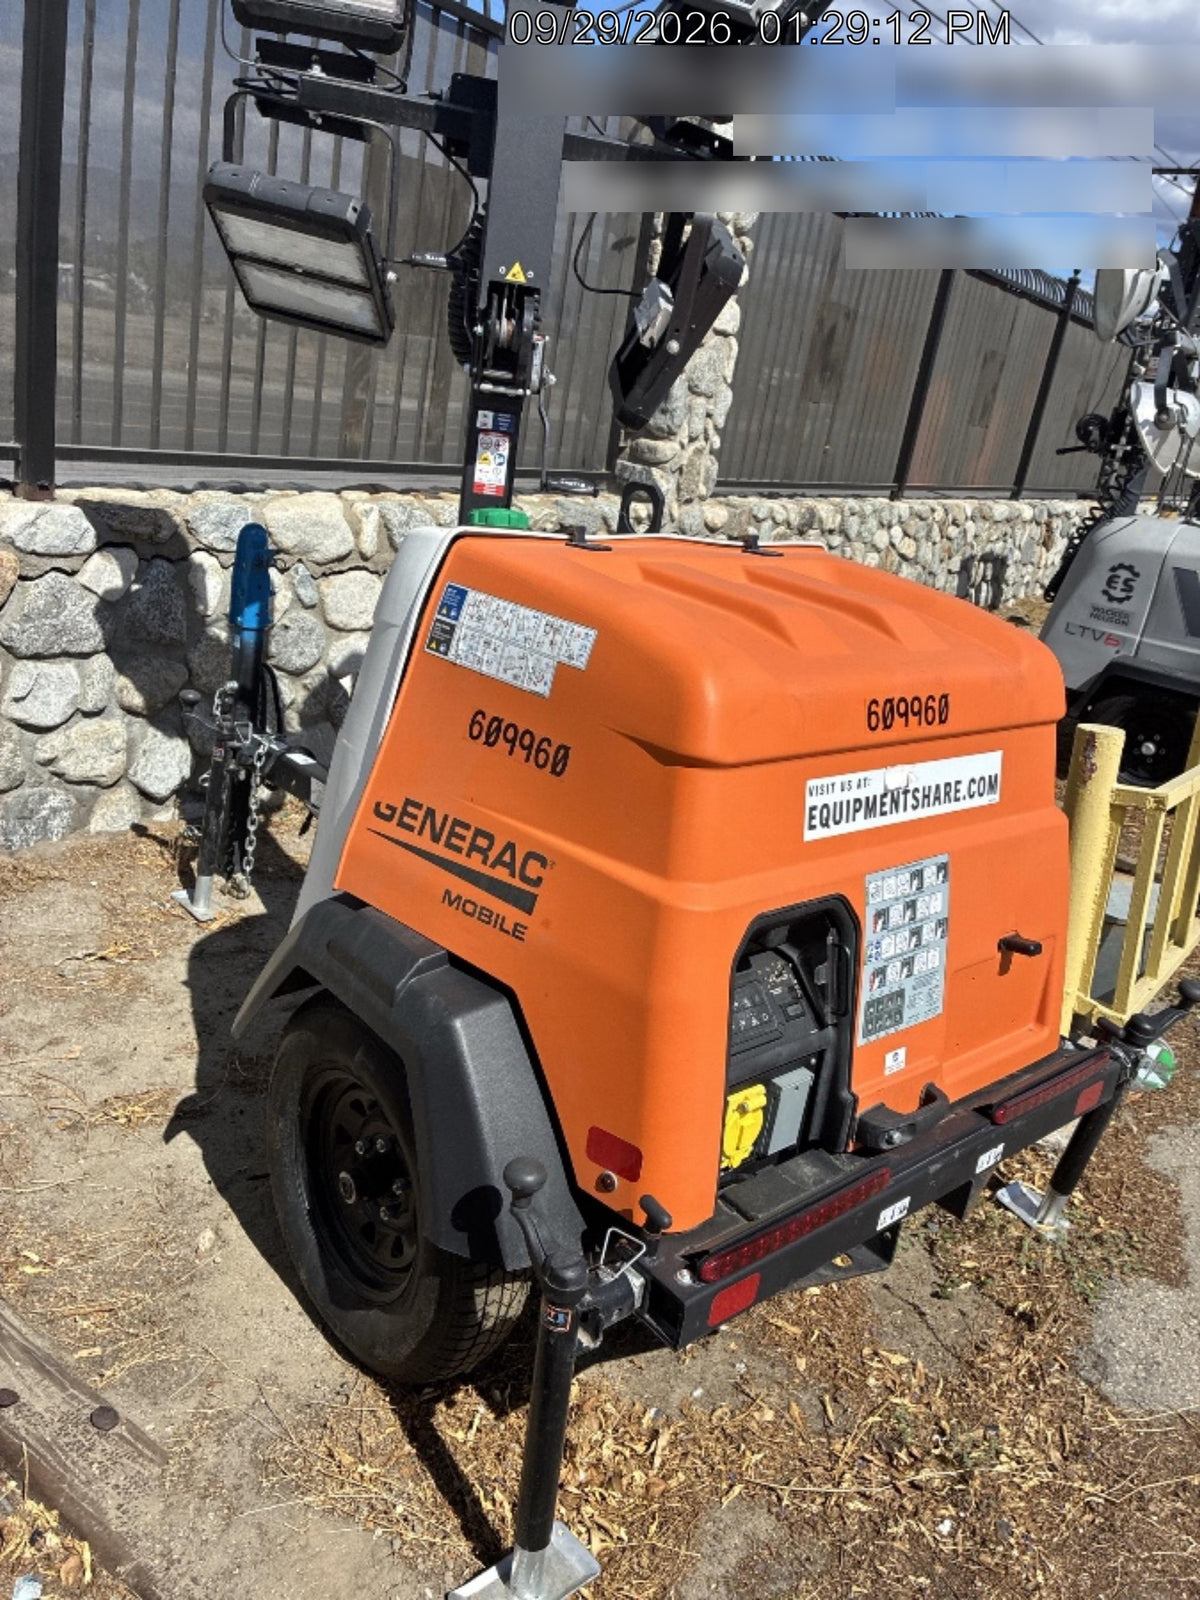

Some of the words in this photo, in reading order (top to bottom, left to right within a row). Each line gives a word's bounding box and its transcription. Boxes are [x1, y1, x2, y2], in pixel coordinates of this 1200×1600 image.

[867, 693, 949, 731] 609960
[468, 709, 571, 777] 609960
[807, 773, 999, 831] EQUIPMENTSHARE.COM
[808, 781, 836, 797] VISIT
[840, 779, 853, 792] US
[856, 777, 873, 791] AT:
[372, 797, 550, 889] GENERAC
[441, 888, 529, 942] MOBILE
